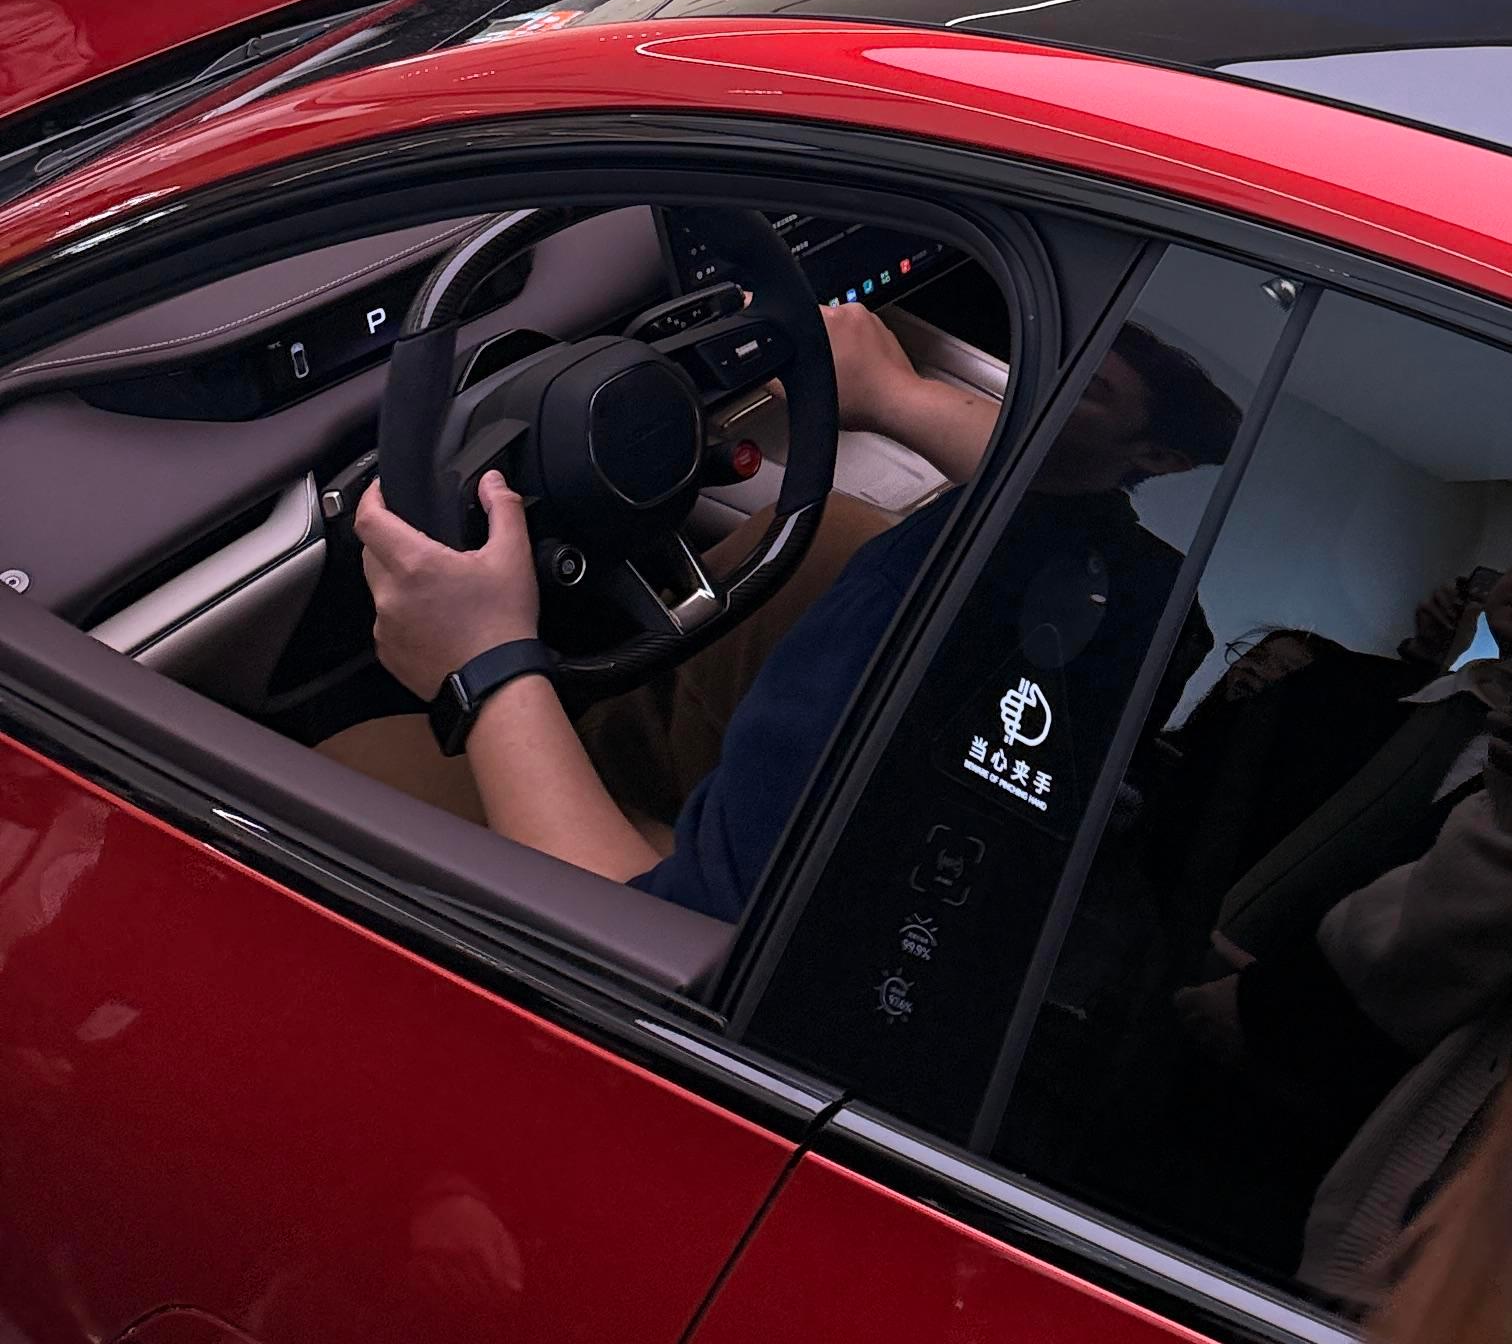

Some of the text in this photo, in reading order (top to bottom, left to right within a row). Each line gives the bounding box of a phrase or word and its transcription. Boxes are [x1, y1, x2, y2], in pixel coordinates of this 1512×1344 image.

[366, 307, 386, 334] P
[968, 734, 1053, 795] 当心夹手
